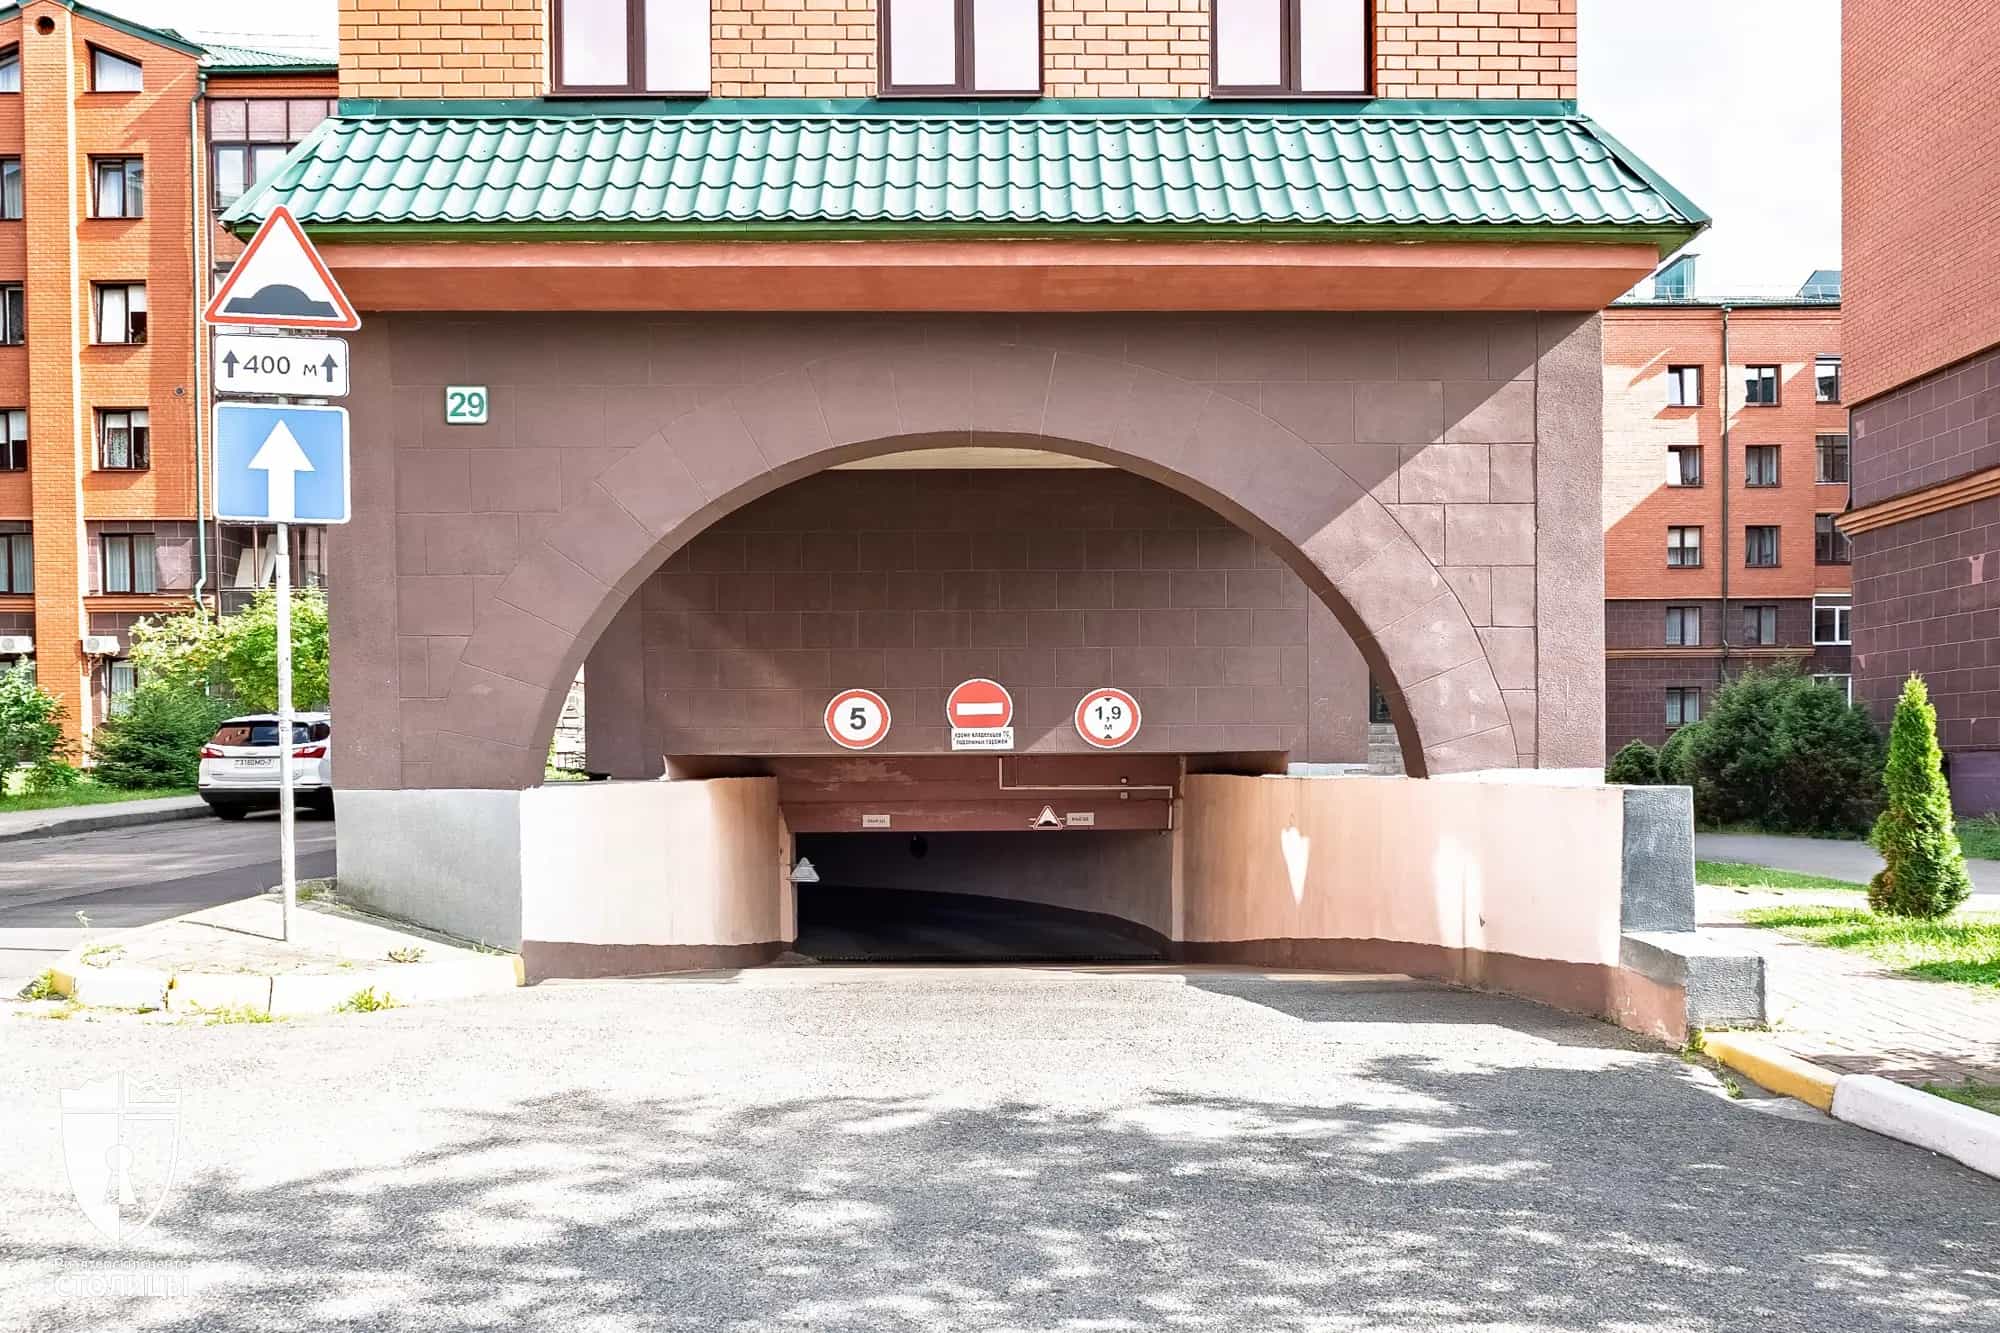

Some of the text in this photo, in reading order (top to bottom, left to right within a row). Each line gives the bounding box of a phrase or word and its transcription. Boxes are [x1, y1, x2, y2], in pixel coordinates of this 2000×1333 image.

[243, 354, 291, 375] 400
[448, 391, 486, 418] 29
[848, 707, 867, 730] 5
[1095, 705, 1122, 722] 1,9
